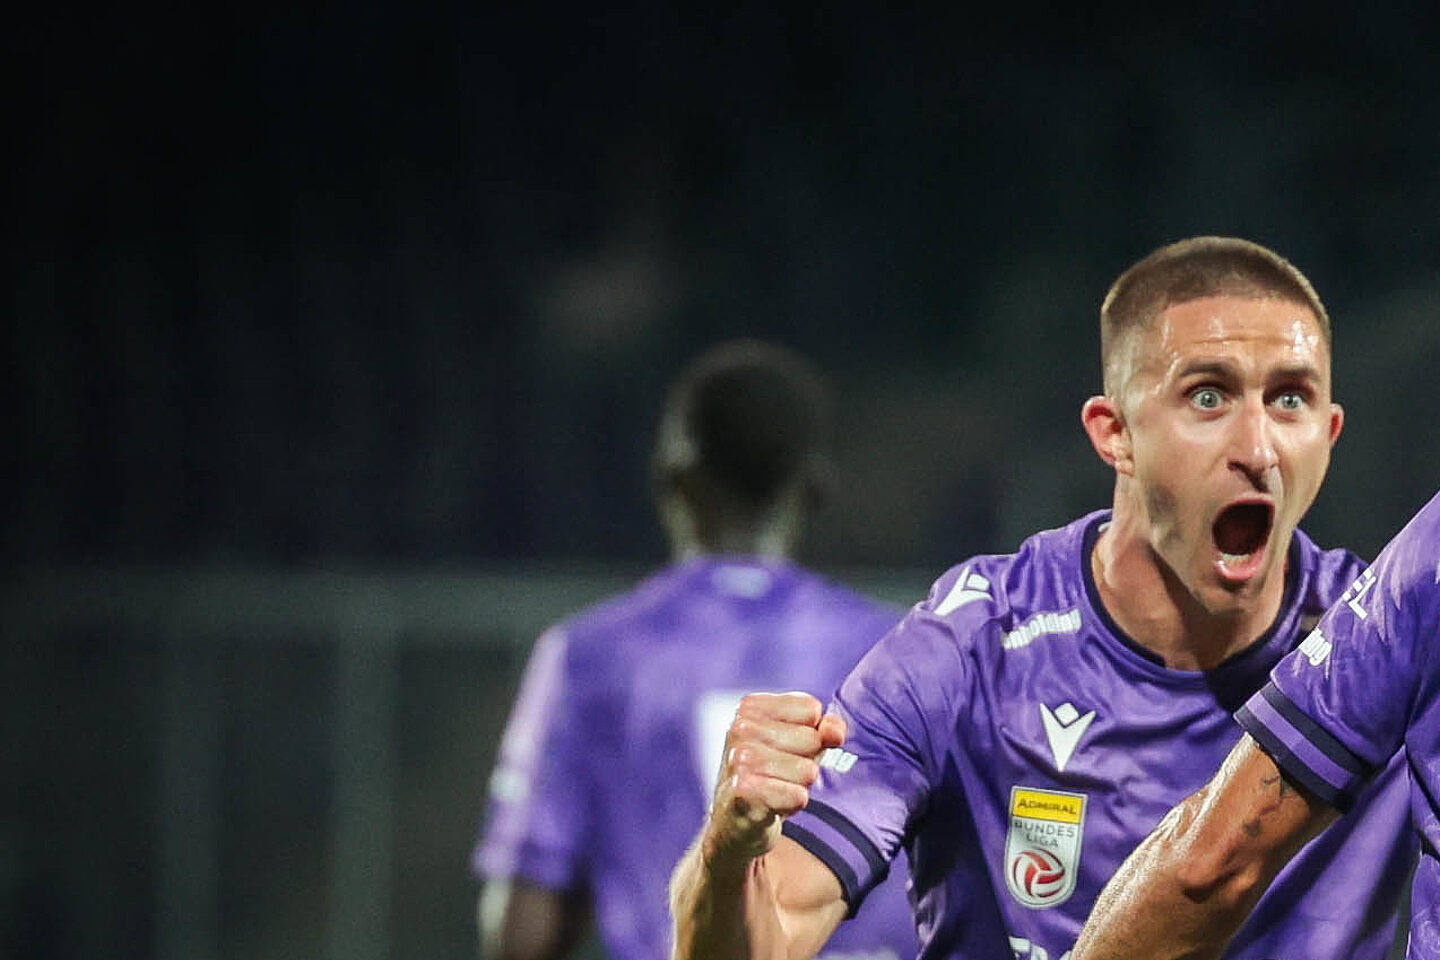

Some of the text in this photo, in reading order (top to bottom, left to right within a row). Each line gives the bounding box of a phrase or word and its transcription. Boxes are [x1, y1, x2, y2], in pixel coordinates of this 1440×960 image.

[1018, 798, 1077, 815] ADMIRAL
[1014, 820, 1075, 838] BUNDES
[1026, 832, 1059, 847] LIGA
